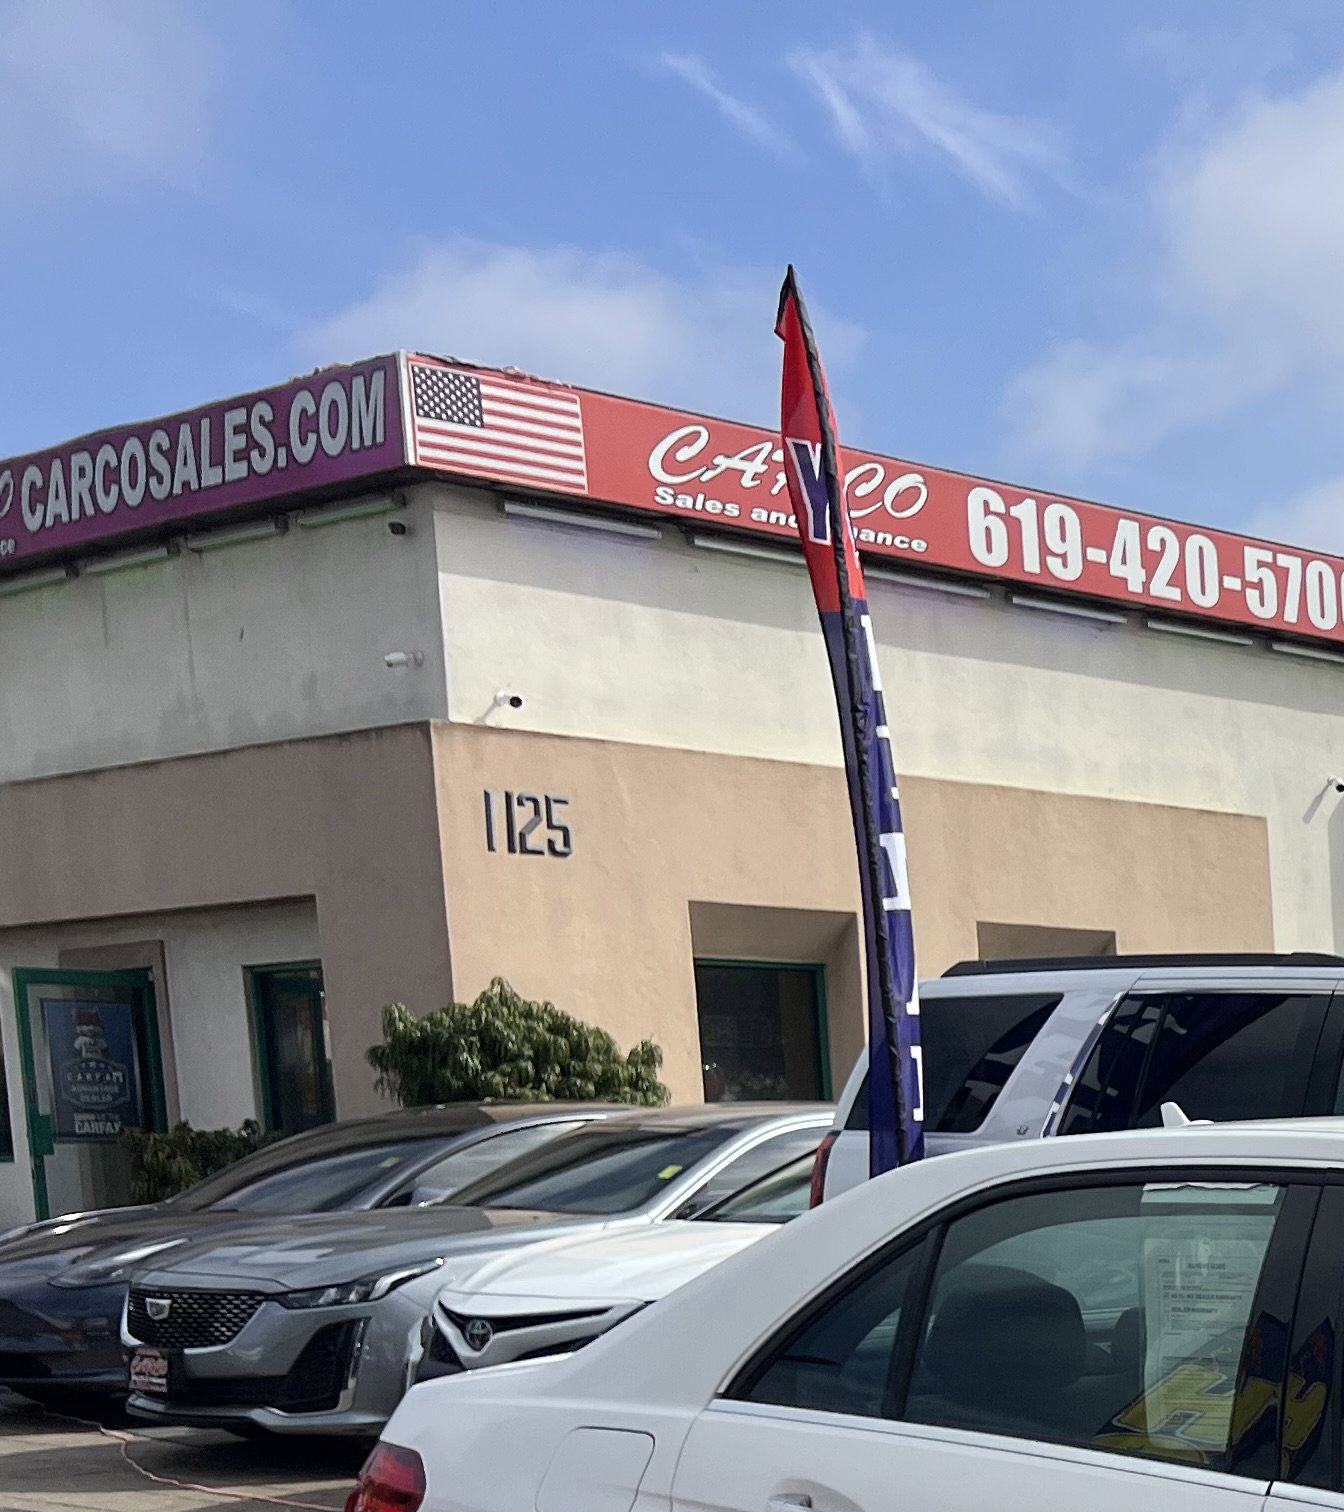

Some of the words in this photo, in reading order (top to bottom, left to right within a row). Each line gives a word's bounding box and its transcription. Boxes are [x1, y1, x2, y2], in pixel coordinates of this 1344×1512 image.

[20, 368, 386, 533] CARCOSALES.COM
[648, 424, 929, 520] CACO
[654, 486, 741, 517] Sales
[484, 788, 573, 859] 1125
